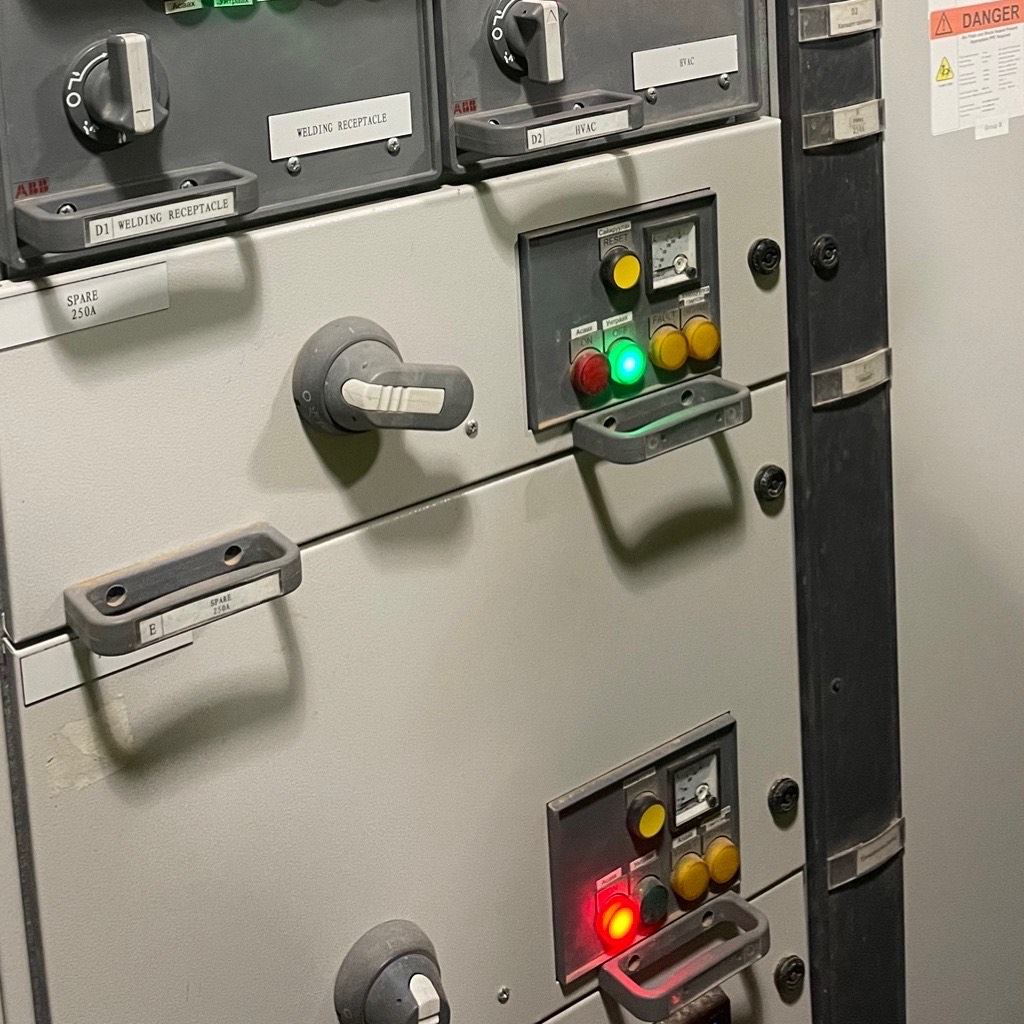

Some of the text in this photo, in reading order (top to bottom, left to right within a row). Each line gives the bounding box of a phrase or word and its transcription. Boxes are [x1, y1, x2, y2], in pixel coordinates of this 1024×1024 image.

[962, 4, 1020, 29] DANGER
[679, 56, 695, 68] HVAC
[454, 99, 477, 115] ABB
[296, 113, 388, 138] WELDING RECEPTACLE
[531, 121, 597, 146] D2 HVAC
[15, 178, 49, 199] ABB
[95, 198, 229, 237] D1 WELDING RECEPTACLE
[603, 233, 628, 246] RESET
[67, 290, 99, 307] SPARE
[71, 305, 97, 321] 250A
[580, 337, 593, 347] ON
[210, 593, 232, 607] SPARE
[213, 603, 231, 615] 250A
